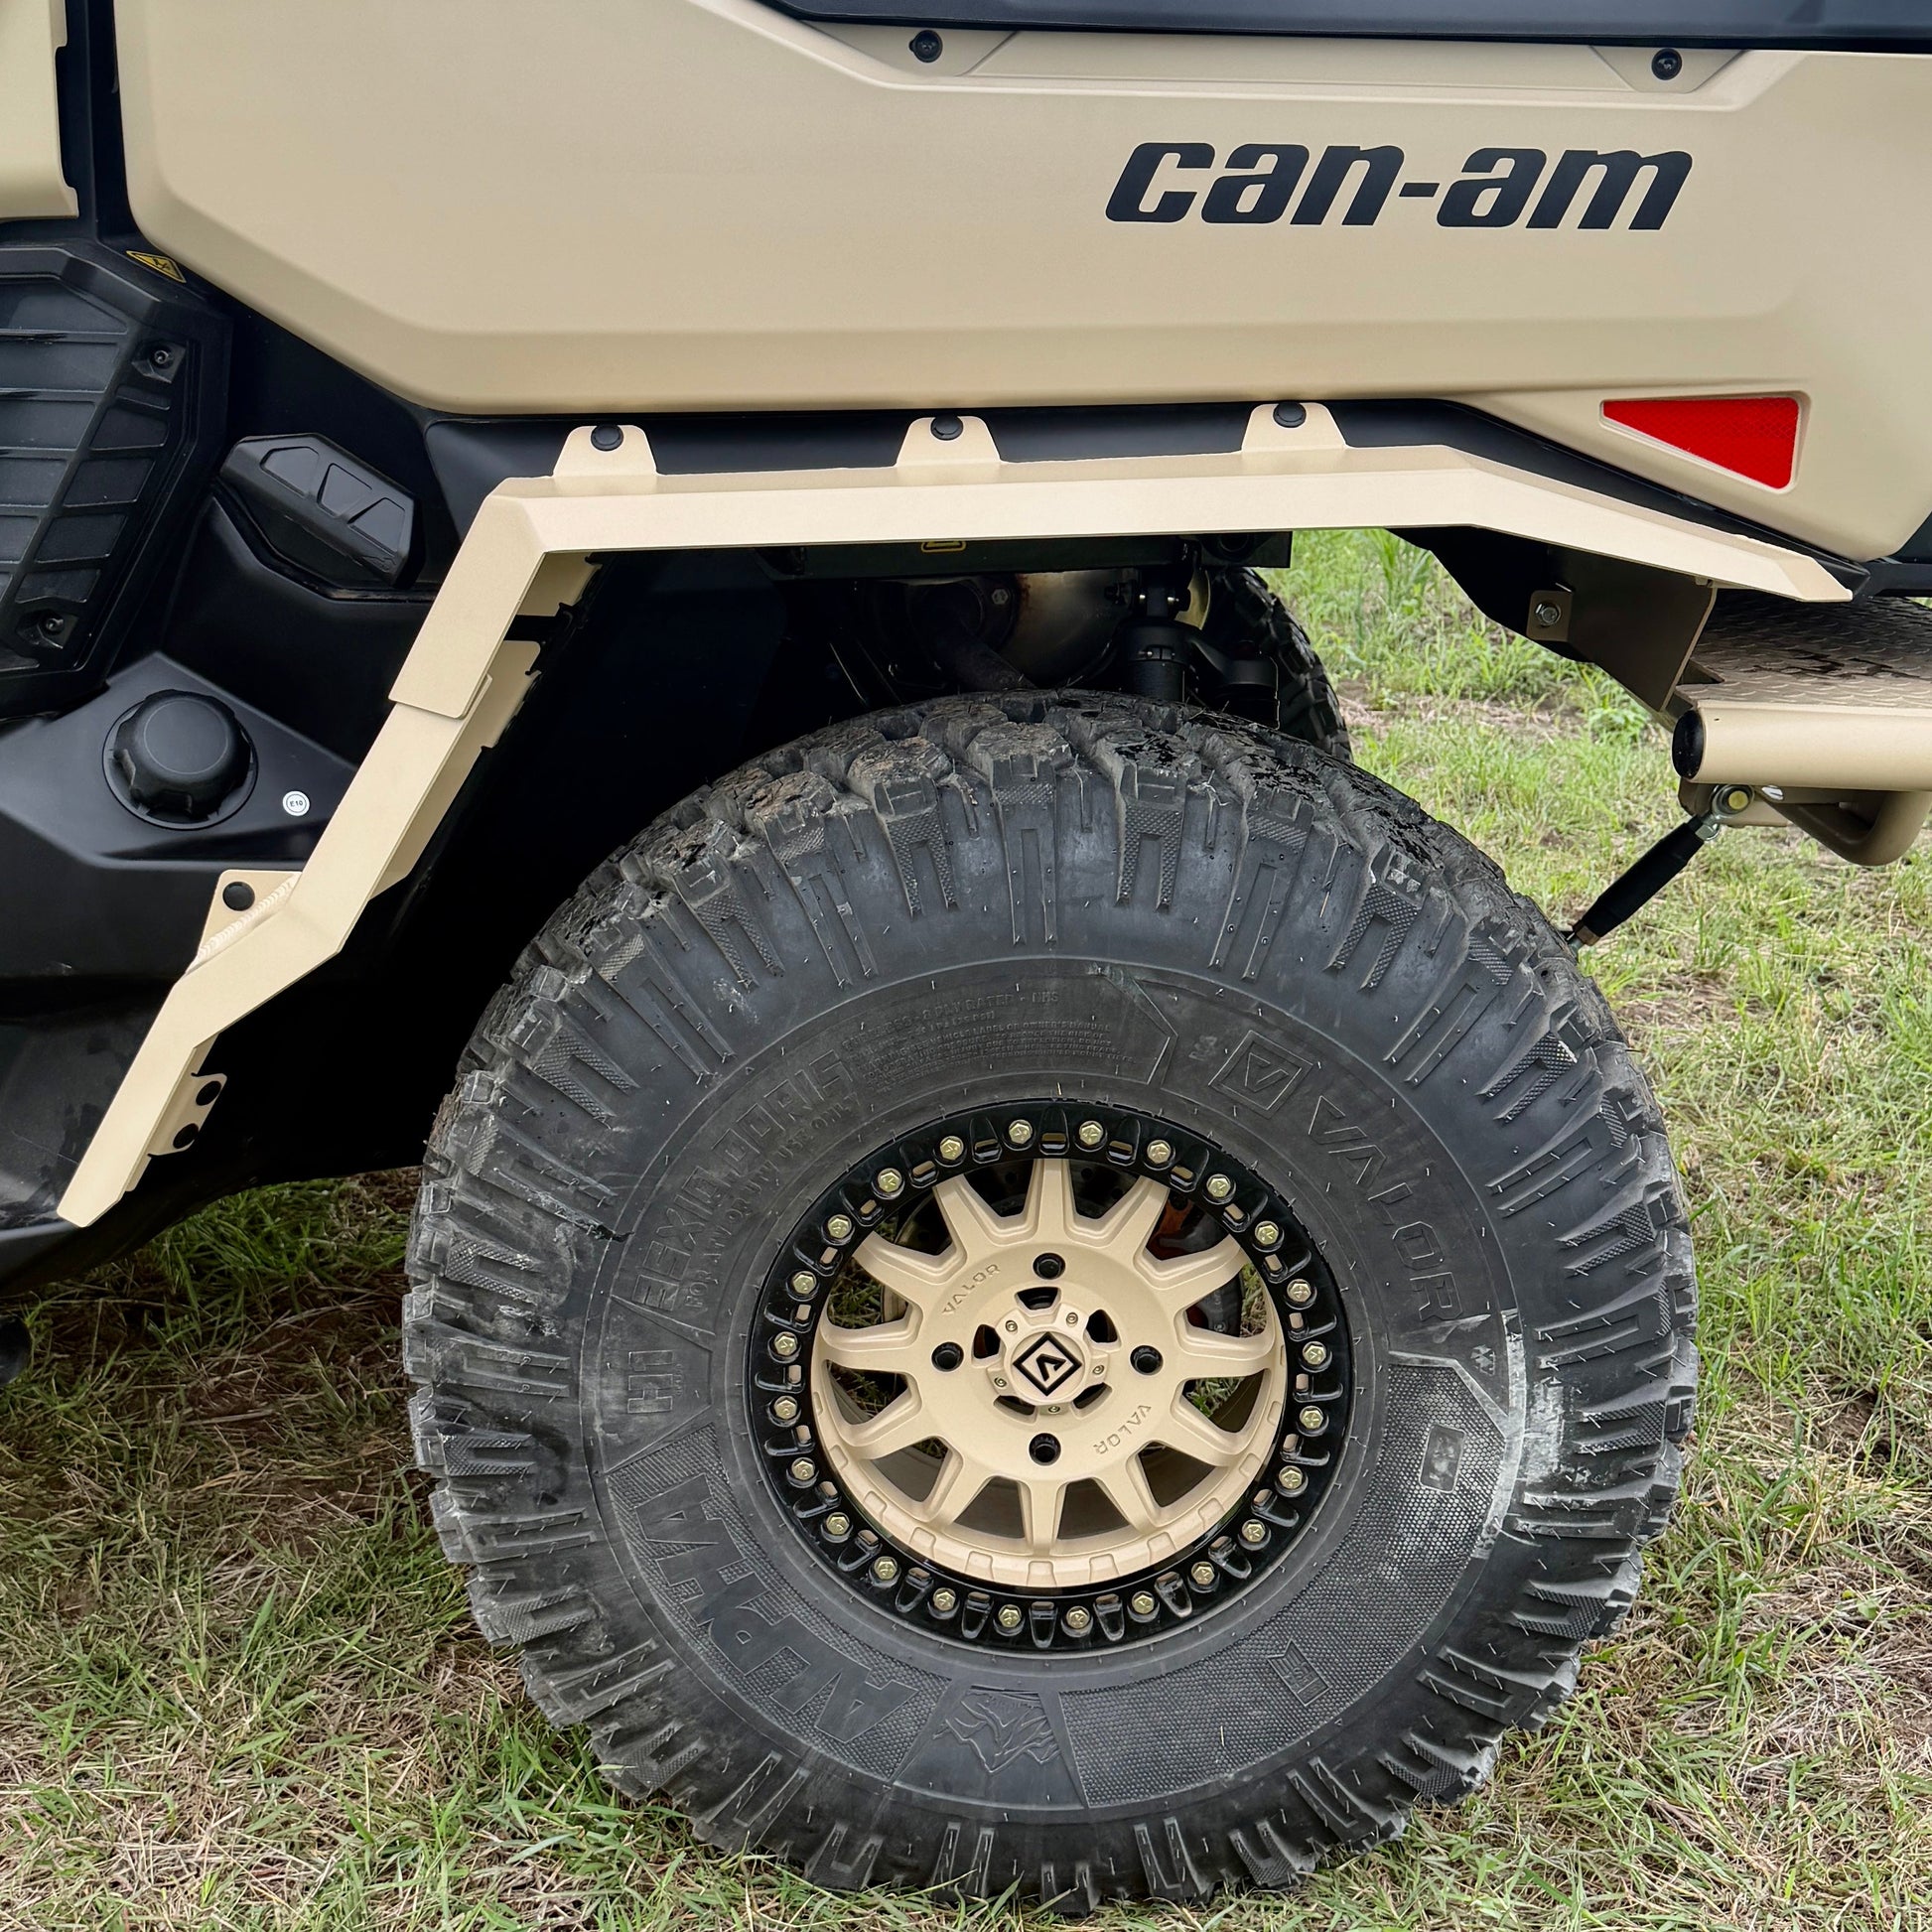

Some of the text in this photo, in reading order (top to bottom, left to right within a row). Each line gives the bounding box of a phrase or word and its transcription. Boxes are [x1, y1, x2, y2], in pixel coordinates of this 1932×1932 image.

[1105, 142, 1693, 230] can-am
[1308, 1095, 1463, 1321] VALOR
[942, 1264, 1001, 1315] VALOR
[1093, 1404, 1152, 1454] VALOR
[635, 1472, 919, 1743] ALPHA
